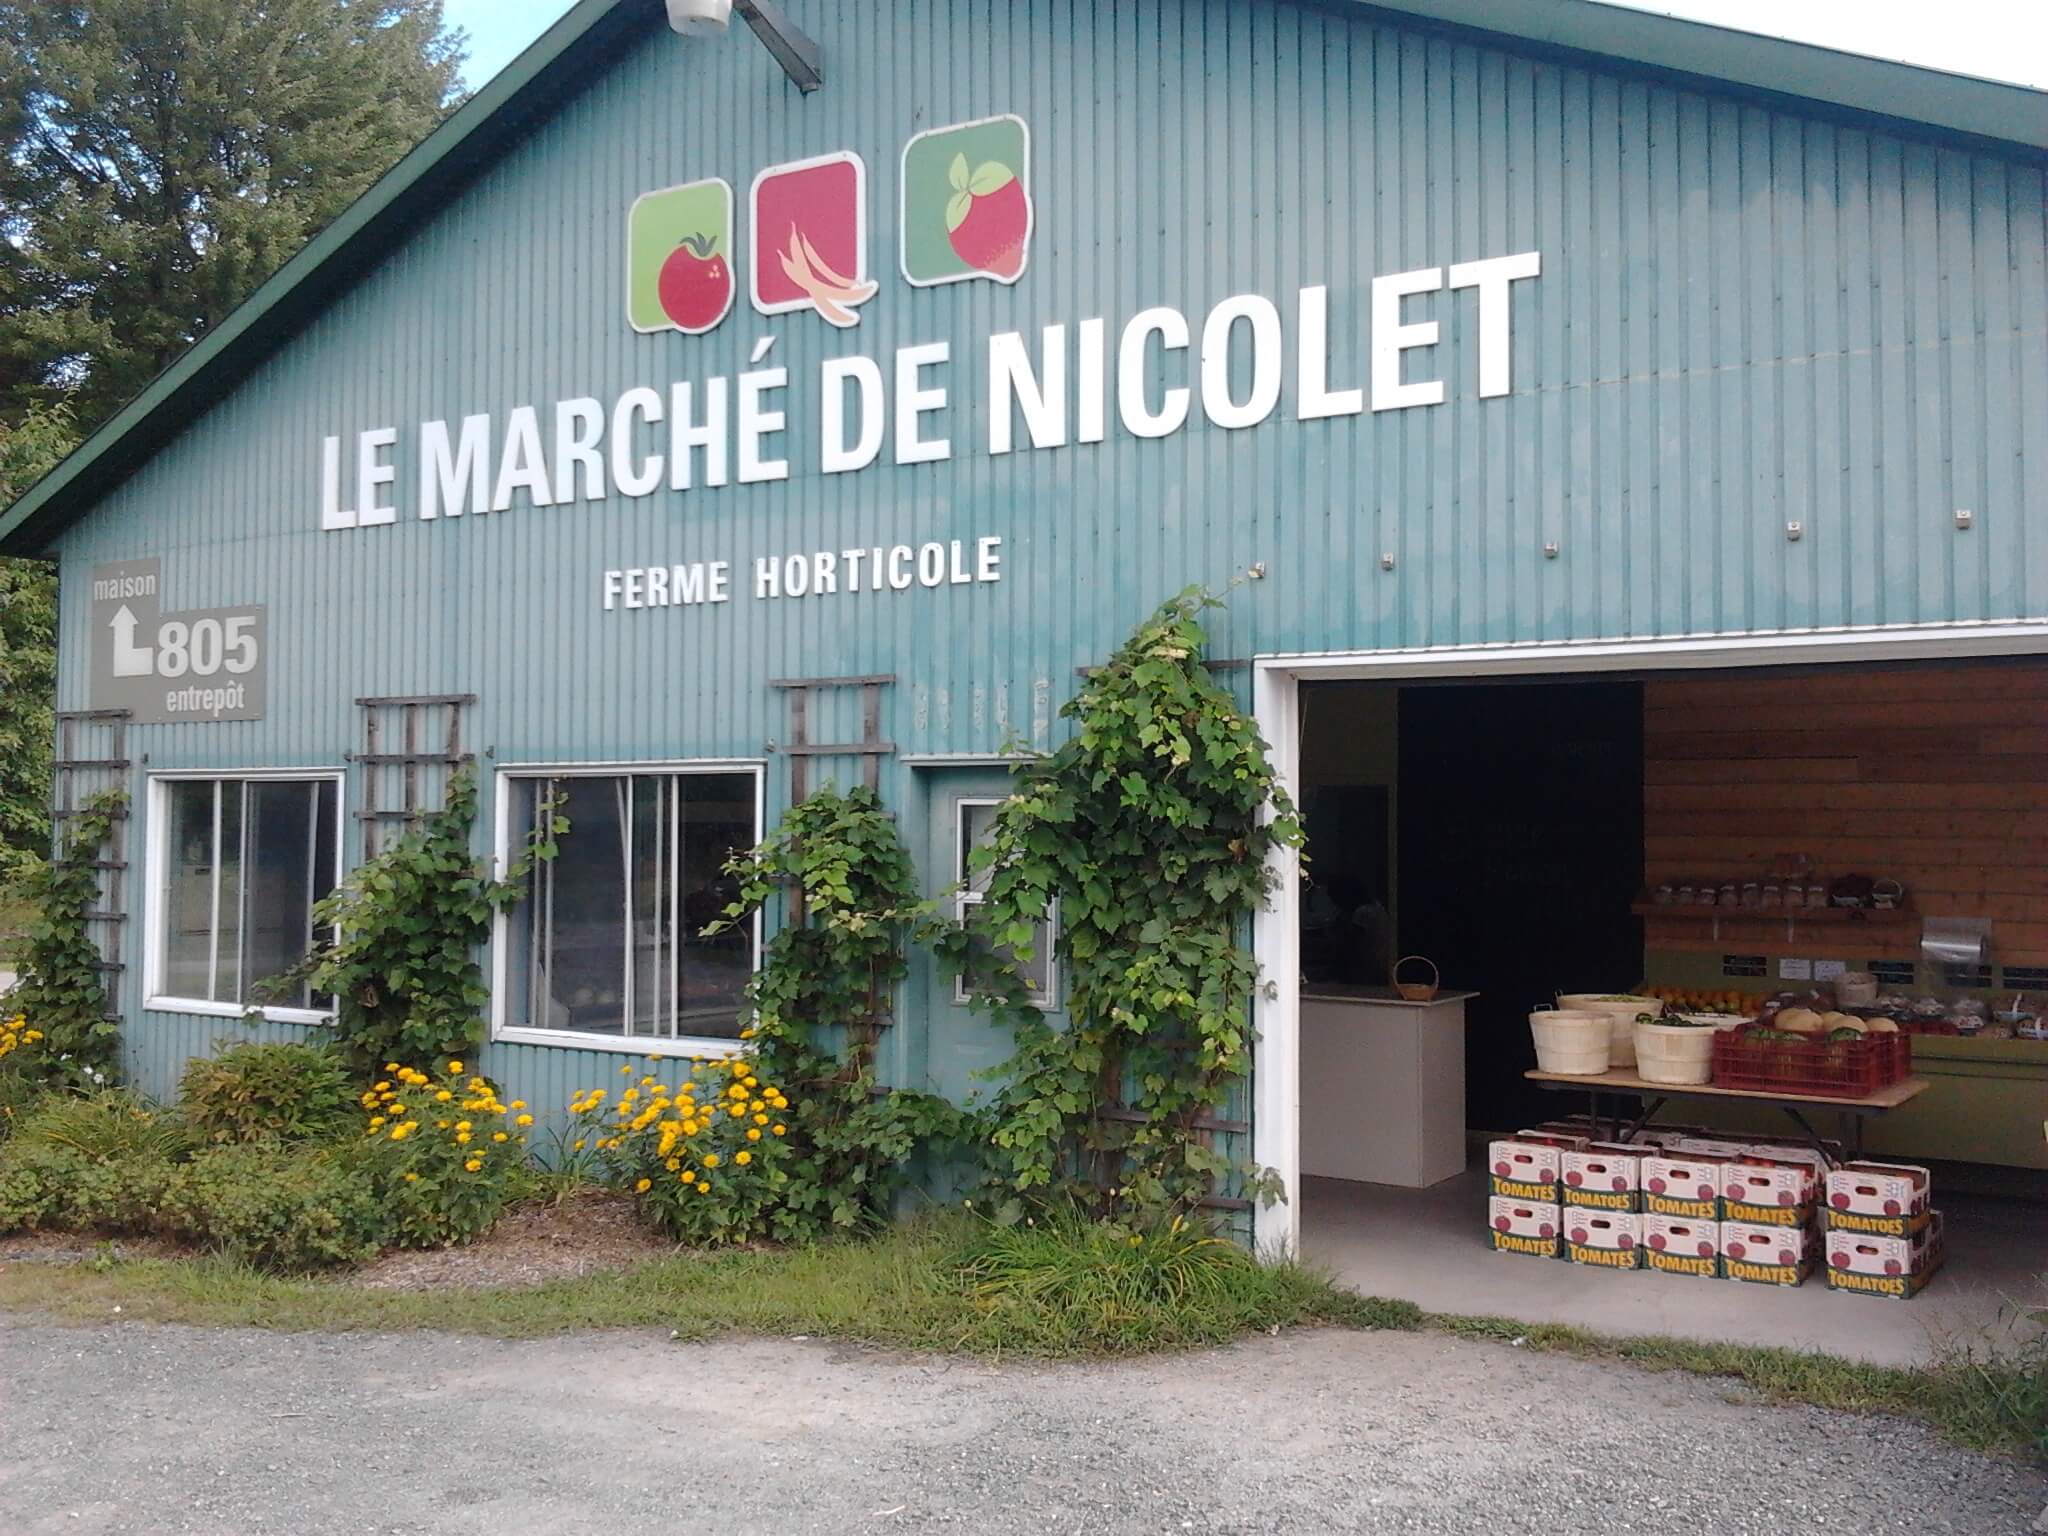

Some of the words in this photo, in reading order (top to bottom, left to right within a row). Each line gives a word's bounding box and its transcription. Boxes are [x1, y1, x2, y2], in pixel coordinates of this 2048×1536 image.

[322, 428, 397, 530] LE
[420, 336, 788, 520] MARCHÉ
[822, 341, 951, 474] DE
[988, 251, 1541, 455] NICOLET
[93, 570, 157, 601] maison
[603, 561, 729, 610] FERME
[755, 536, 1001, 599] HORTICOLE
[157, 615, 258, 678] 805
[166, 680, 246, 718] entrepôt
[1493, 1177, 1556, 1201] TOMATES
[1564, 1189, 1630, 1209] TOMATOES
[1646, 1195, 1715, 1217] TOMATES
[1724, 1200, 1796, 1225] TOMATES
[1828, 1209, 1904, 1236] TOMATOES
[1493, 1231, 1555, 1256] TOMATES
[1569, 1243, 1635, 1267] TOMATES
[1646, 1251, 1715, 1275] TOMATES
[1724, 1259, 1797, 1284] TOMATES
[1828, 1268, 1905, 1295] TOMATOES
